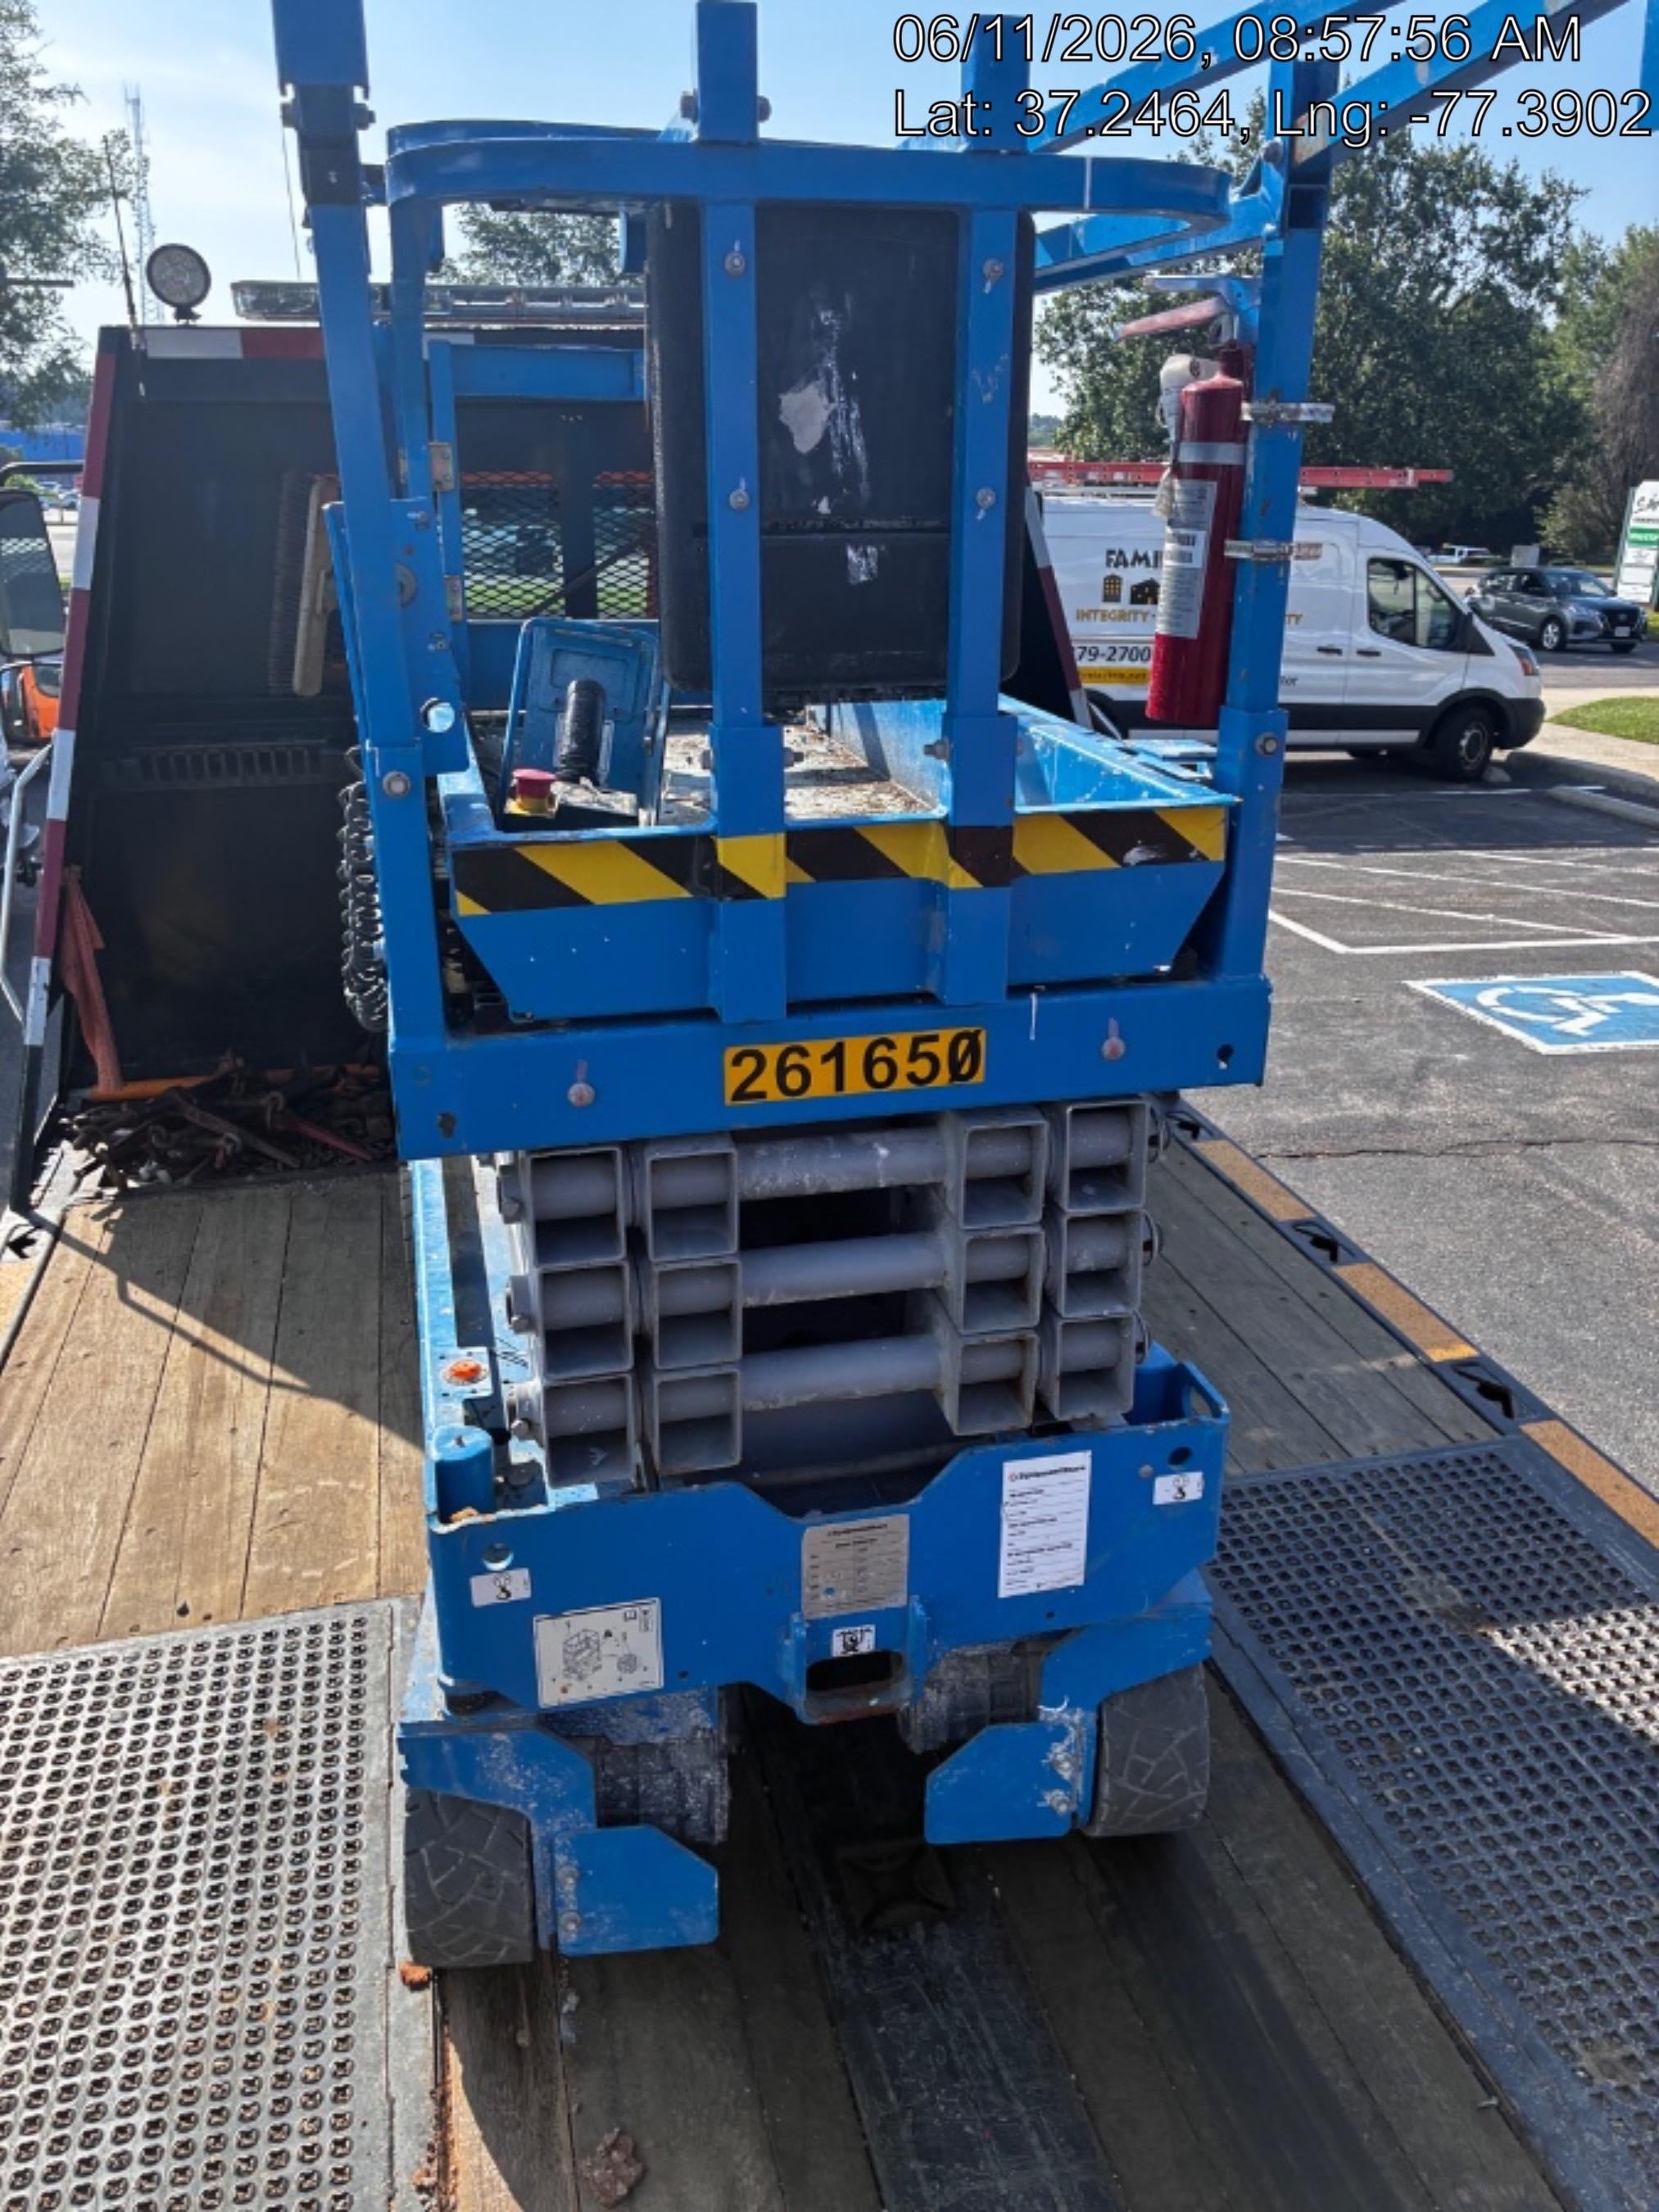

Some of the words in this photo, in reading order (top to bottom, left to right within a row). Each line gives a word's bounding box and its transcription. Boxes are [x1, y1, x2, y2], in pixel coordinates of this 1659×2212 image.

[1106, 549, 1163, 569] FAMI
[1076, 609, 1148, 623] INTEGRITY
[1072, 646, 1151, 663] 79-2700
